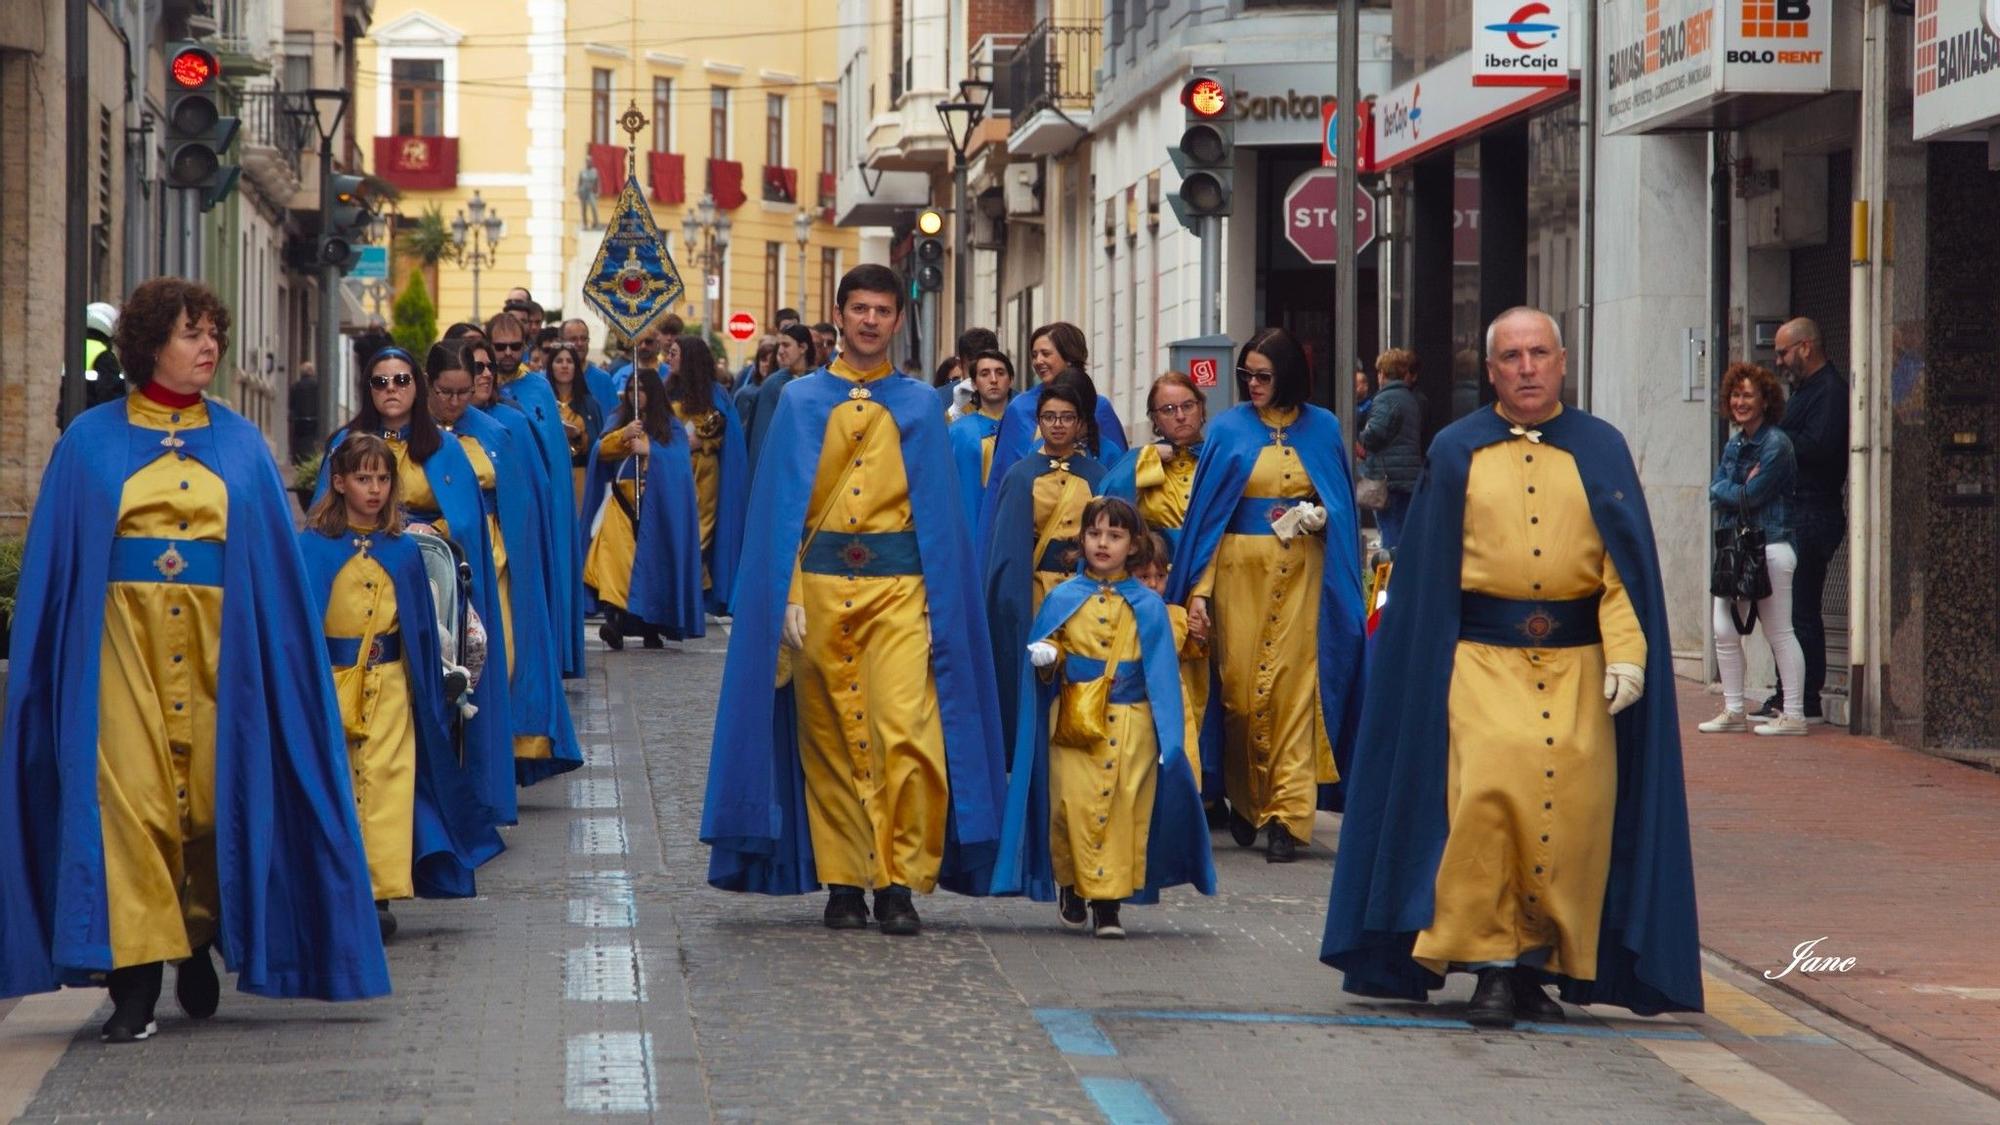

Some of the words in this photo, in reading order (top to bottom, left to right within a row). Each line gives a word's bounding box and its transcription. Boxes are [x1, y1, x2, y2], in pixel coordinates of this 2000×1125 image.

[1485, 53, 1558, 71] iberCaja
[1609, 39, 1645, 90] BAMASA
[1660, 20, 1685, 69] BOLO
[1727, 50, 1775, 63] BOLO
[1777, 51, 1823, 64] RENT
[1938, 27, 2000, 88] BAMASA
[1235, 88, 1378, 120] Santa
[1294, 207, 1367, 228] STP
